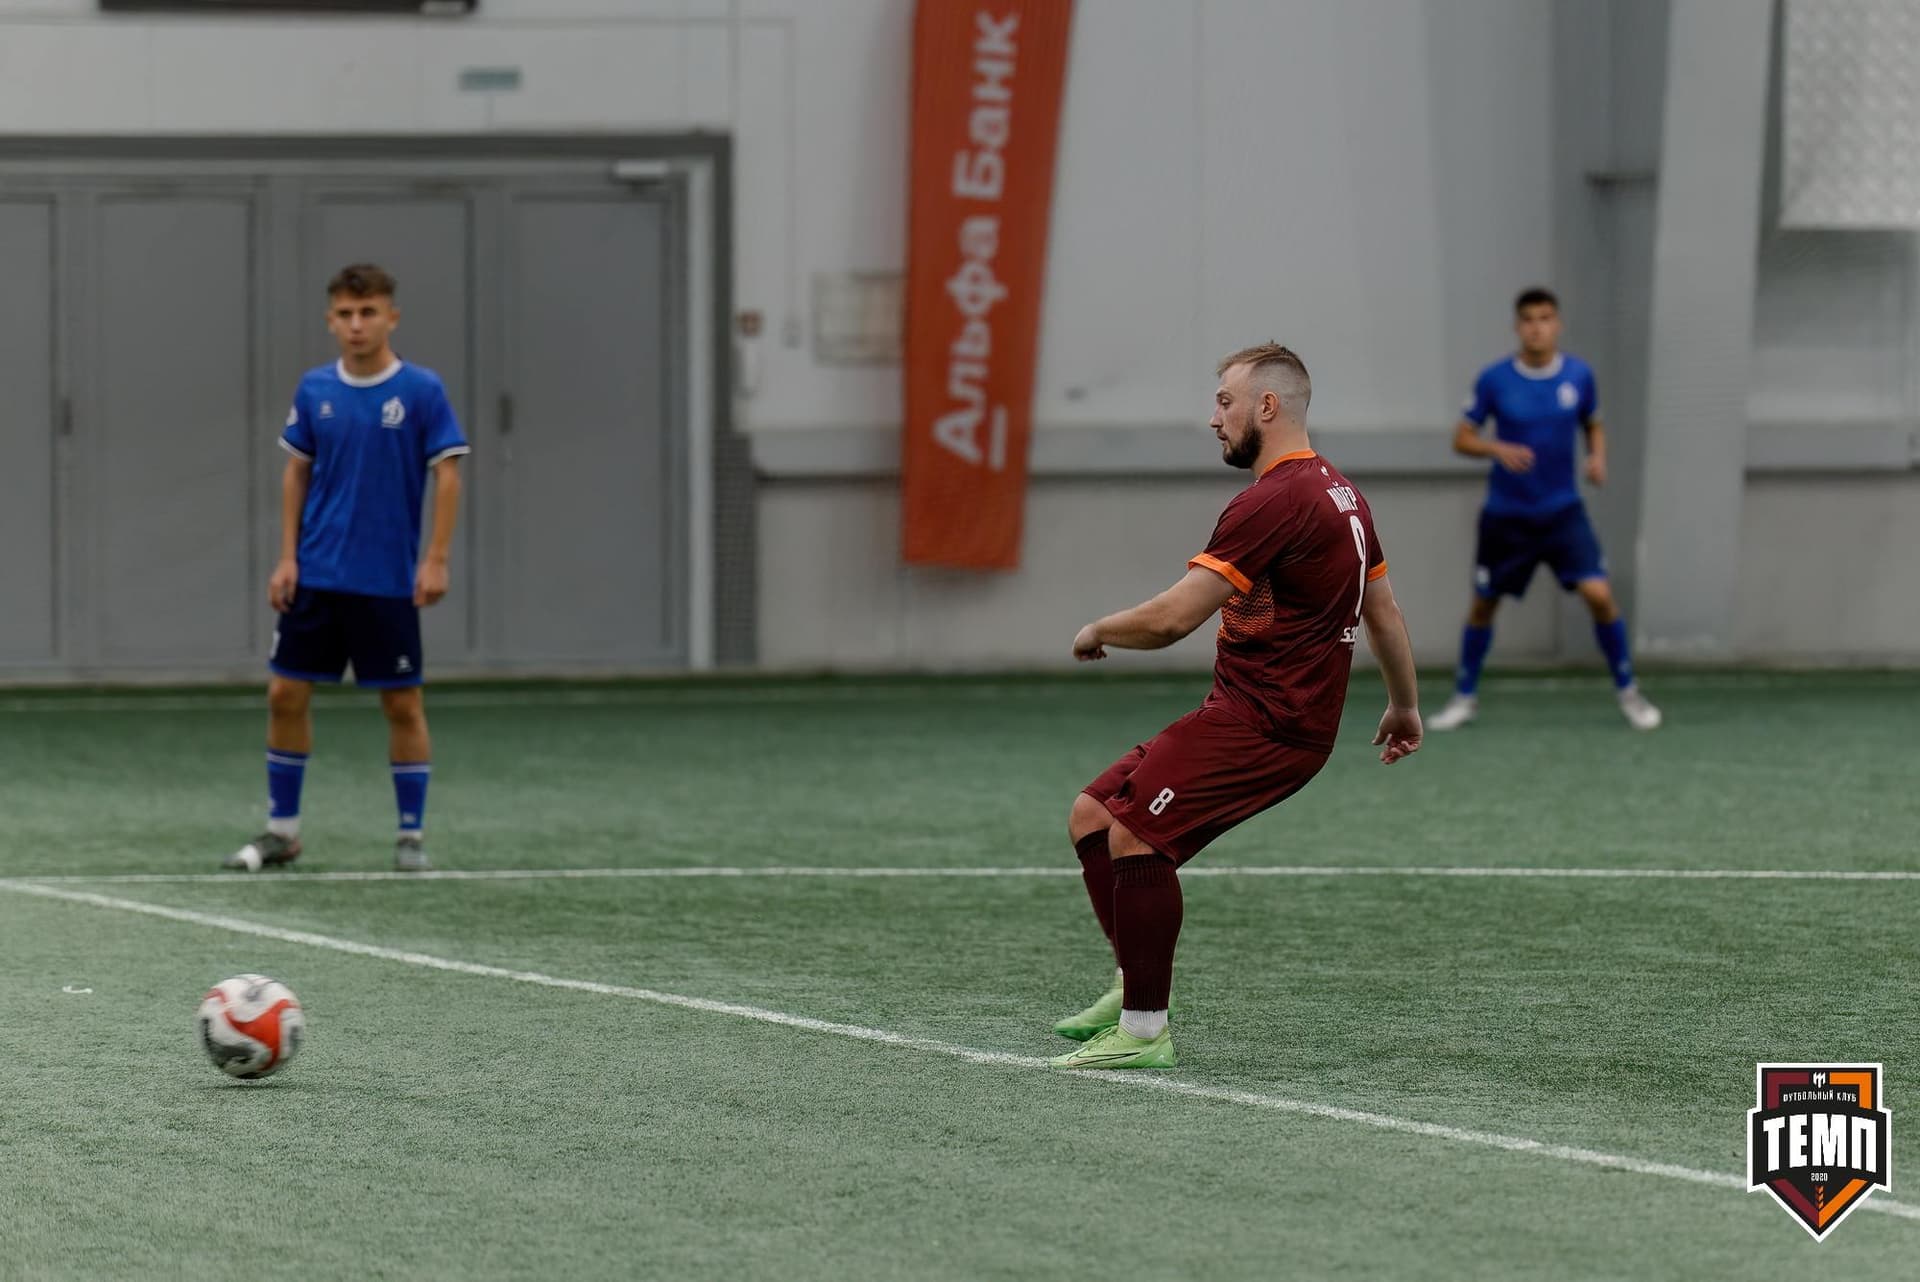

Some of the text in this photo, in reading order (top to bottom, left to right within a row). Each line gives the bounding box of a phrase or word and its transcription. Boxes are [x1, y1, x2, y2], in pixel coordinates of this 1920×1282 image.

[931, 10, 1019, 465] Альфа Банк
[1148, 787, 1176, 816] 8
